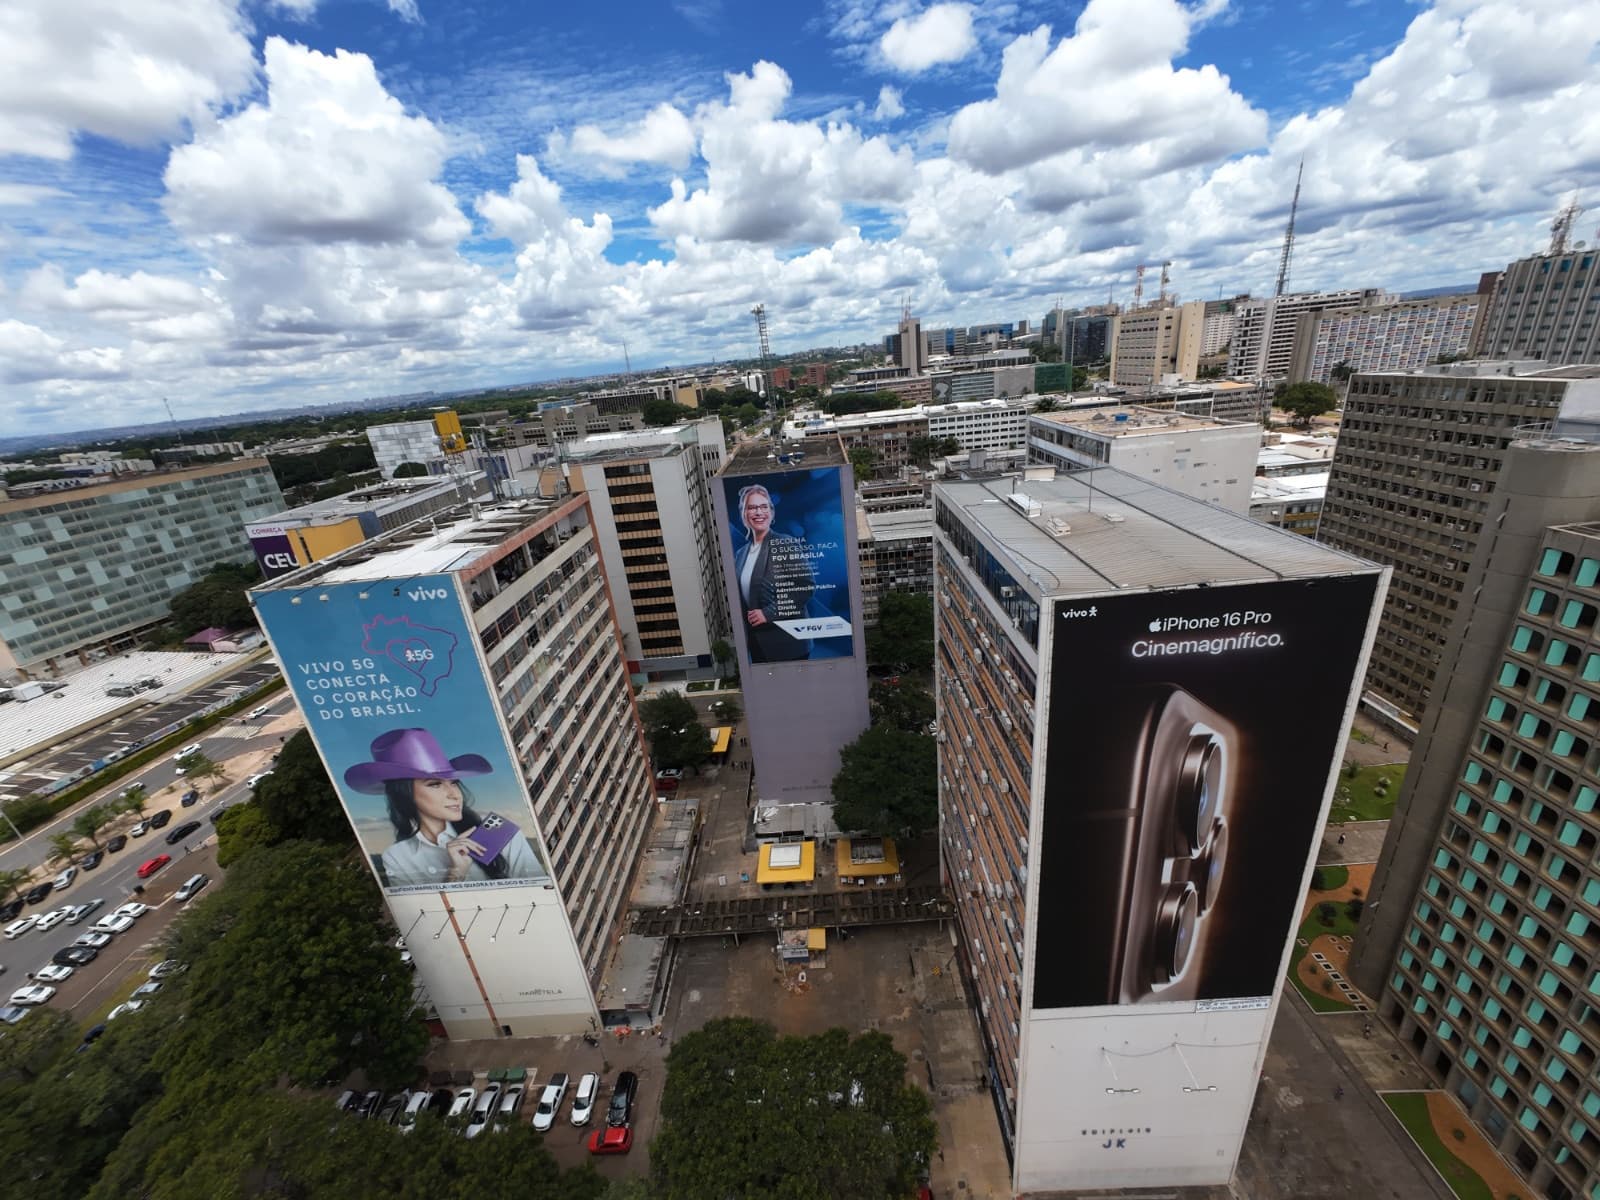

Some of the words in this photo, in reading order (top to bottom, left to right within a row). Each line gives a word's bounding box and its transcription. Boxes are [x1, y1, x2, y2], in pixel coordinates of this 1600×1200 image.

[770, 537, 806, 546] ESCOLHA
[408, 586, 448, 602] vivo
[1062, 608, 1088, 618] vivo
[1162, 617, 1219, 631] iPhone
[1222, 612, 1240, 626] 16
[1244, 611, 1272, 624] Pro
[1132, 632, 1284, 658] Cinemagnífico.
[414, 648, 434, 661] 5G
[298, 660, 344, 674] VIVO
[352, 658, 374, 670] 5G
[306, 674, 390, 690] CONECTA
[313, 694, 325, 704] O
[332, 686, 416, 703] CORAÇÃO
[320, 708, 344, 720] DO
[350, 702, 421, 717] BRASIL.
